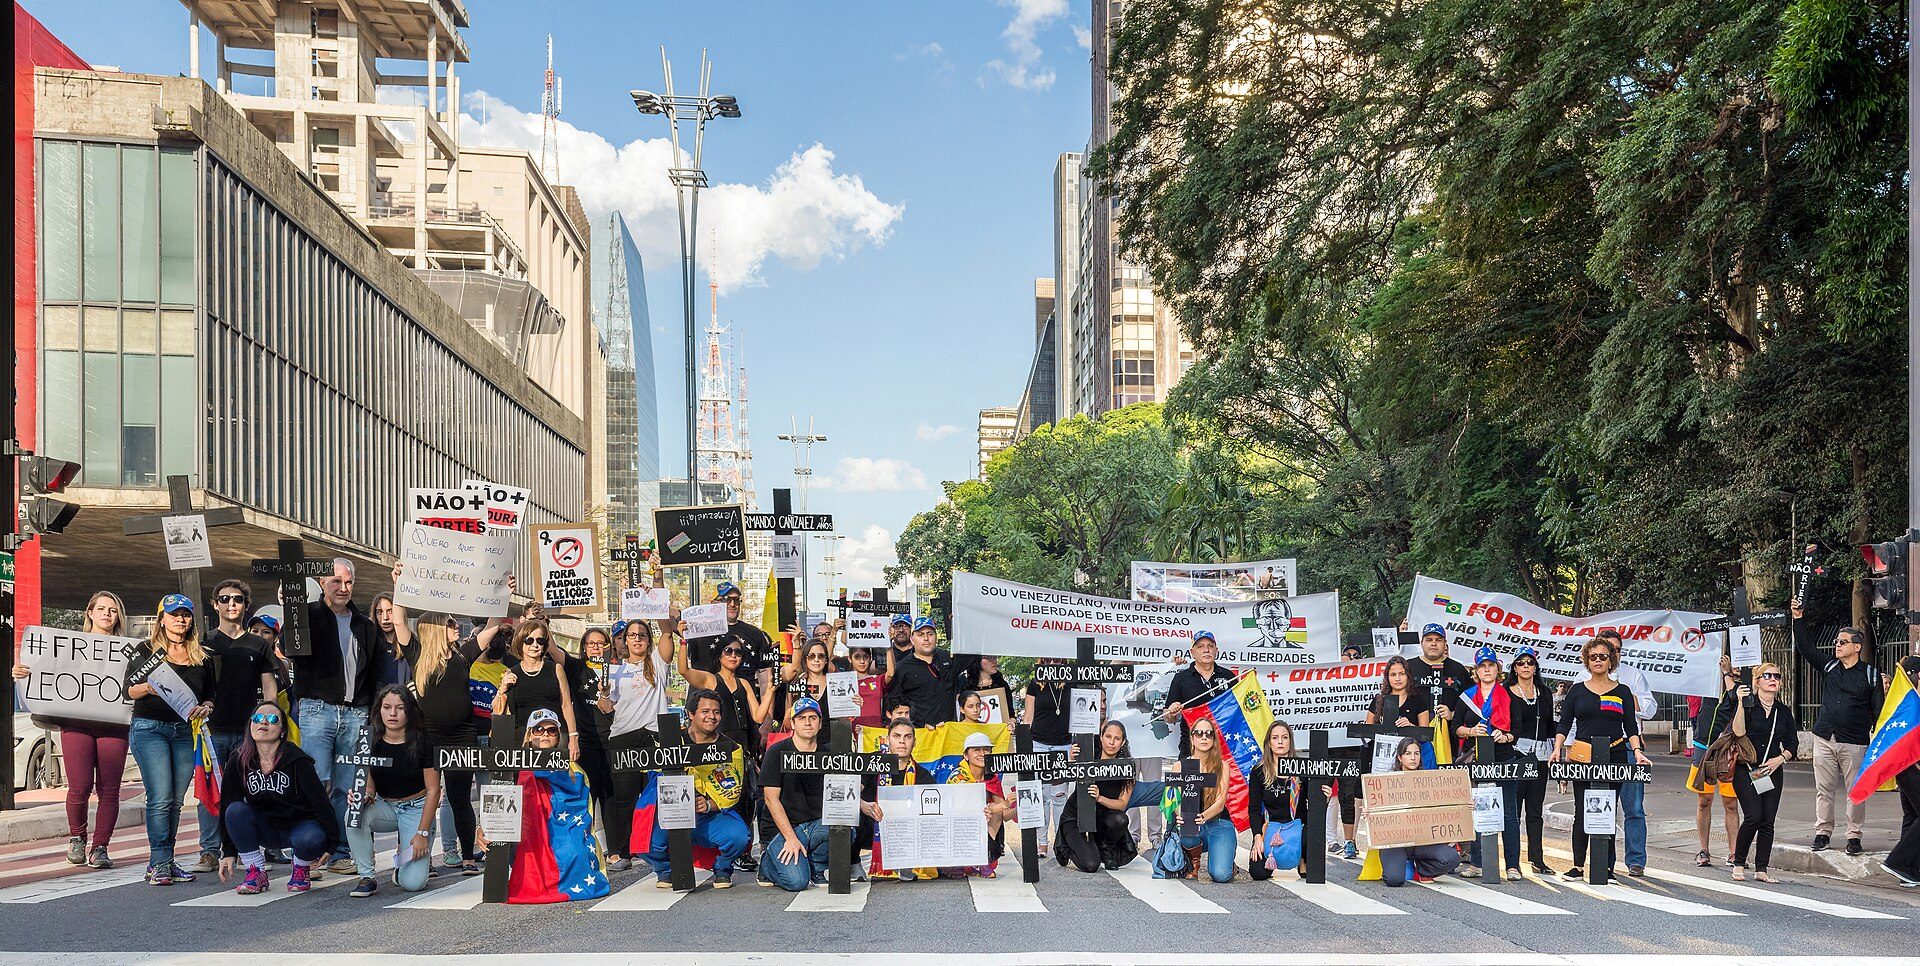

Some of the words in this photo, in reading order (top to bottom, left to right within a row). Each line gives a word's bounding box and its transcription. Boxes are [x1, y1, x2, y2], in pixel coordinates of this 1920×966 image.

[416, 492, 465, 510] NÃO
[458, 543, 475, 553] QUE
[484, 547, 504, 556] MEU
[688, 537, 743, 559] Buzine
[411, 566, 471, 585] VENEZUELA
[549, 569, 576, 580] FORA
[400, 584, 420, 595] ONDE
[430, 590, 451, 599] NASCI
[546, 578, 589, 589] MADURO
[981, 585, 1007, 597] SOU
[1010, 589, 1107, 610] VENEZUELANO,
[1021, 603, 1093, 620] LIBERDADE
[1096, 611, 1112, 621] DE
[1466, 602, 1541, 635] FORA
[851, 619, 867, 629] NO
[1011, 617, 1039, 630] QUE
[1041, 620, 1082, 632] AINDA
[1085, 623, 1128, 635] EXISTE
[1131, 627, 1150, 636] NO
[1445, 621, 1477, 635] NÃO
[1497, 632, 1558, 651] MORTES,
[26, 633, 122, 663] #FREE
[1132, 646, 1172, 658] MUITO
[1239, 651, 1315, 663] LIBERDADES
[129, 652, 165, 684] MANUEL
[1036, 666, 1073, 681] CARLOS
[1077, 666, 1114, 681] MORENO
[1295, 685, 1327, 695] CANAL
[1287, 696, 1314, 706] PELA
[1294, 705, 1331, 715] PRESOS
[550, 751, 561, 760] 19
[613, 749, 650, 770] JAIRO
[654, 744, 692, 766] ORTIZ
[706, 744, 717, 753] 19
[336, 755, 387, 766] ALBERT
[439, 747, 487, 768] DANIEL
[494, 747, 542, 769] QUELIZ
[783, 752, 819, 770] MIGUEL
[821, 752, 864, 772] CASTILLO
[990, 754, 1013, 773] JUAN
[1279, 758, 1306, 775] PAOLA
[1086, 764, 1133, 778] CARMONA
[1550, 764, 1592, 780] GRUSENY
[1593, 764, 1632, 781] CANELON
[246, 769, 290, 796] GAP
[1367, 778, 1382, 791] 40
[1387, 777, 1406, 790] DIAS
[1412, 776, 1462, 790] PROTESTANDO
[350, 768, 366, 827] APONTE
[924, 797, 938, 805] RIP
[1387, 791, 1417, 803] MORTOS
[1419, 790, 1432, 801] POR
[1369, 815, 1402, 827] MADURO
[1431, 824, 1464, 840] FORA
